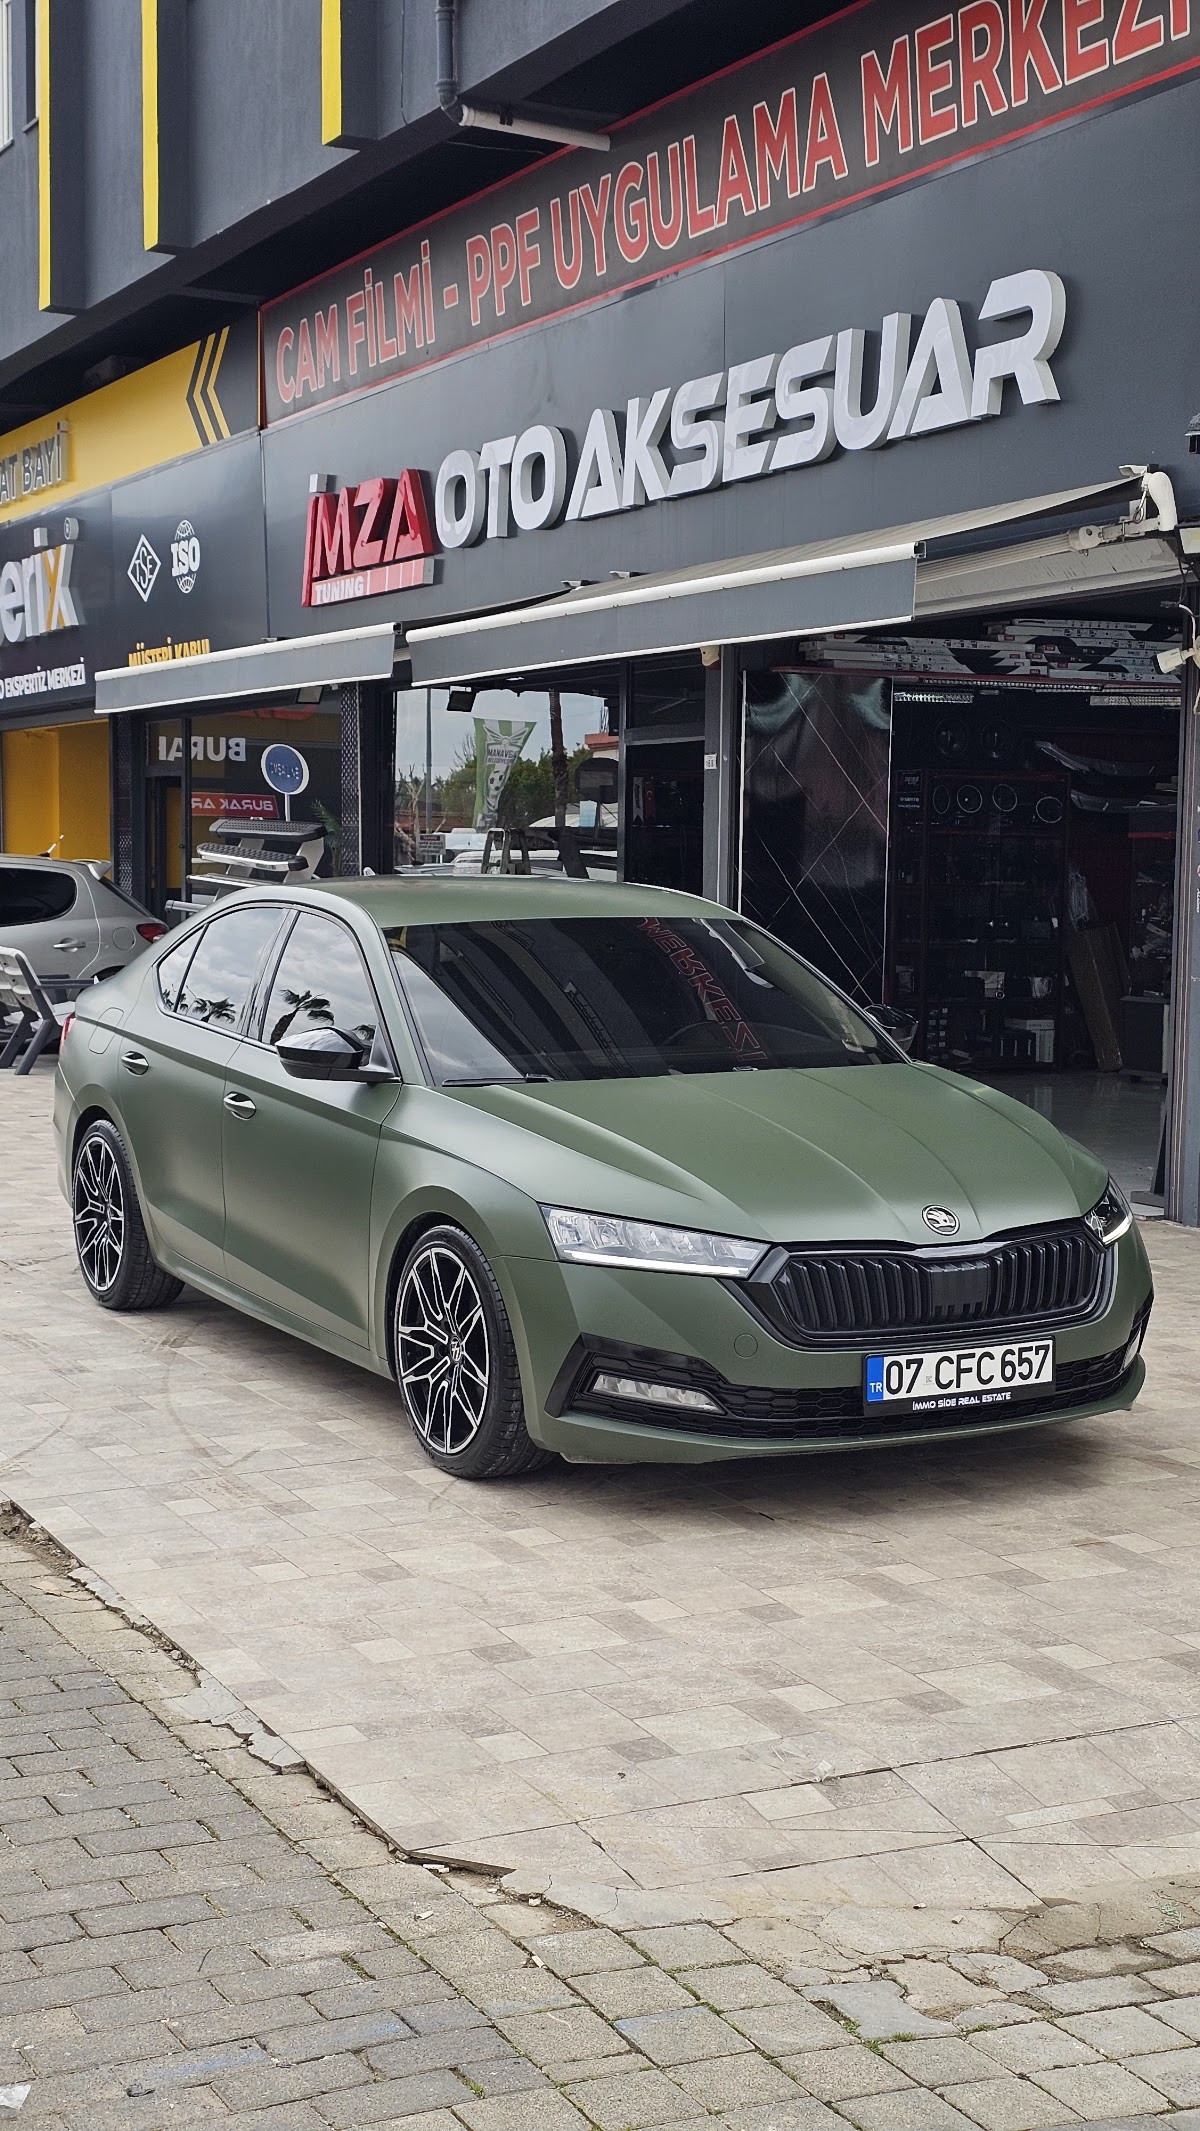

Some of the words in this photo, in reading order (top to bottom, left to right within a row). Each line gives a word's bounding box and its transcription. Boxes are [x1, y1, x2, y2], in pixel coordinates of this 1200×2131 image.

[276, 304, 340, 403] CAM
[346, 239, 435, 375] FİLMİ
[466, 207, 540, 326] PPF
[550, 72, 848, 289] UYGULAMA
[435, 425, 566, 549] OTO
[565, 269, 1066, 521] AKSESUAR
[135, 546, 153, 589] TSE
[171, 537, 200, 577] ISO
[0, 527, 79, 643] erix
[315, 576, 364, 604] TUNING
[5, 666, 47, 698] EKSPERTİZ
[47, 657, 86, 690] MERKEZİ
[870, 1382, 882, 1393] TR
[885, 1357, 923, 1395] 07
[935, 1352, 995, 1389] CFC
[1001, 1344, 1050, 1382] 657
[958, 1396, 980, 1406] REAL
[982, 1392, 1011, 1402] ESTATE
